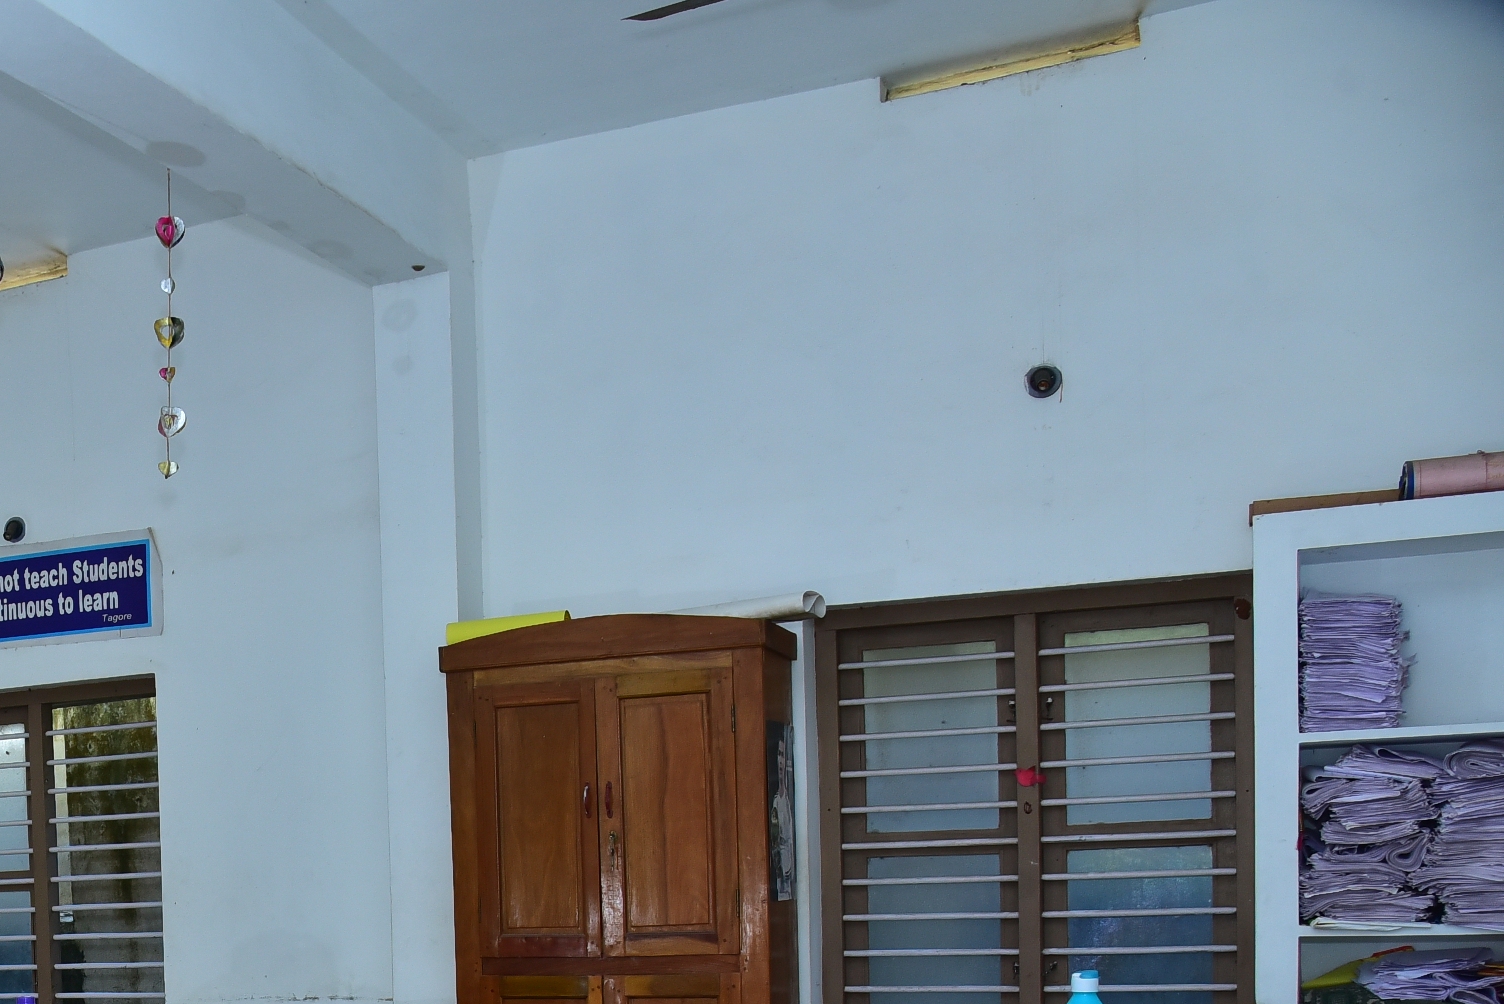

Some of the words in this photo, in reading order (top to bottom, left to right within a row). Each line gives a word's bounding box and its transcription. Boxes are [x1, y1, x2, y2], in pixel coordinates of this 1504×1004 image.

[24, 563, 67, 590] teach
[73, 555, 143, 584] Students
[58, 593, 73, 614] to
[79, 590, 118, 612] learn
[102, 612, 132, 624] Tagore
